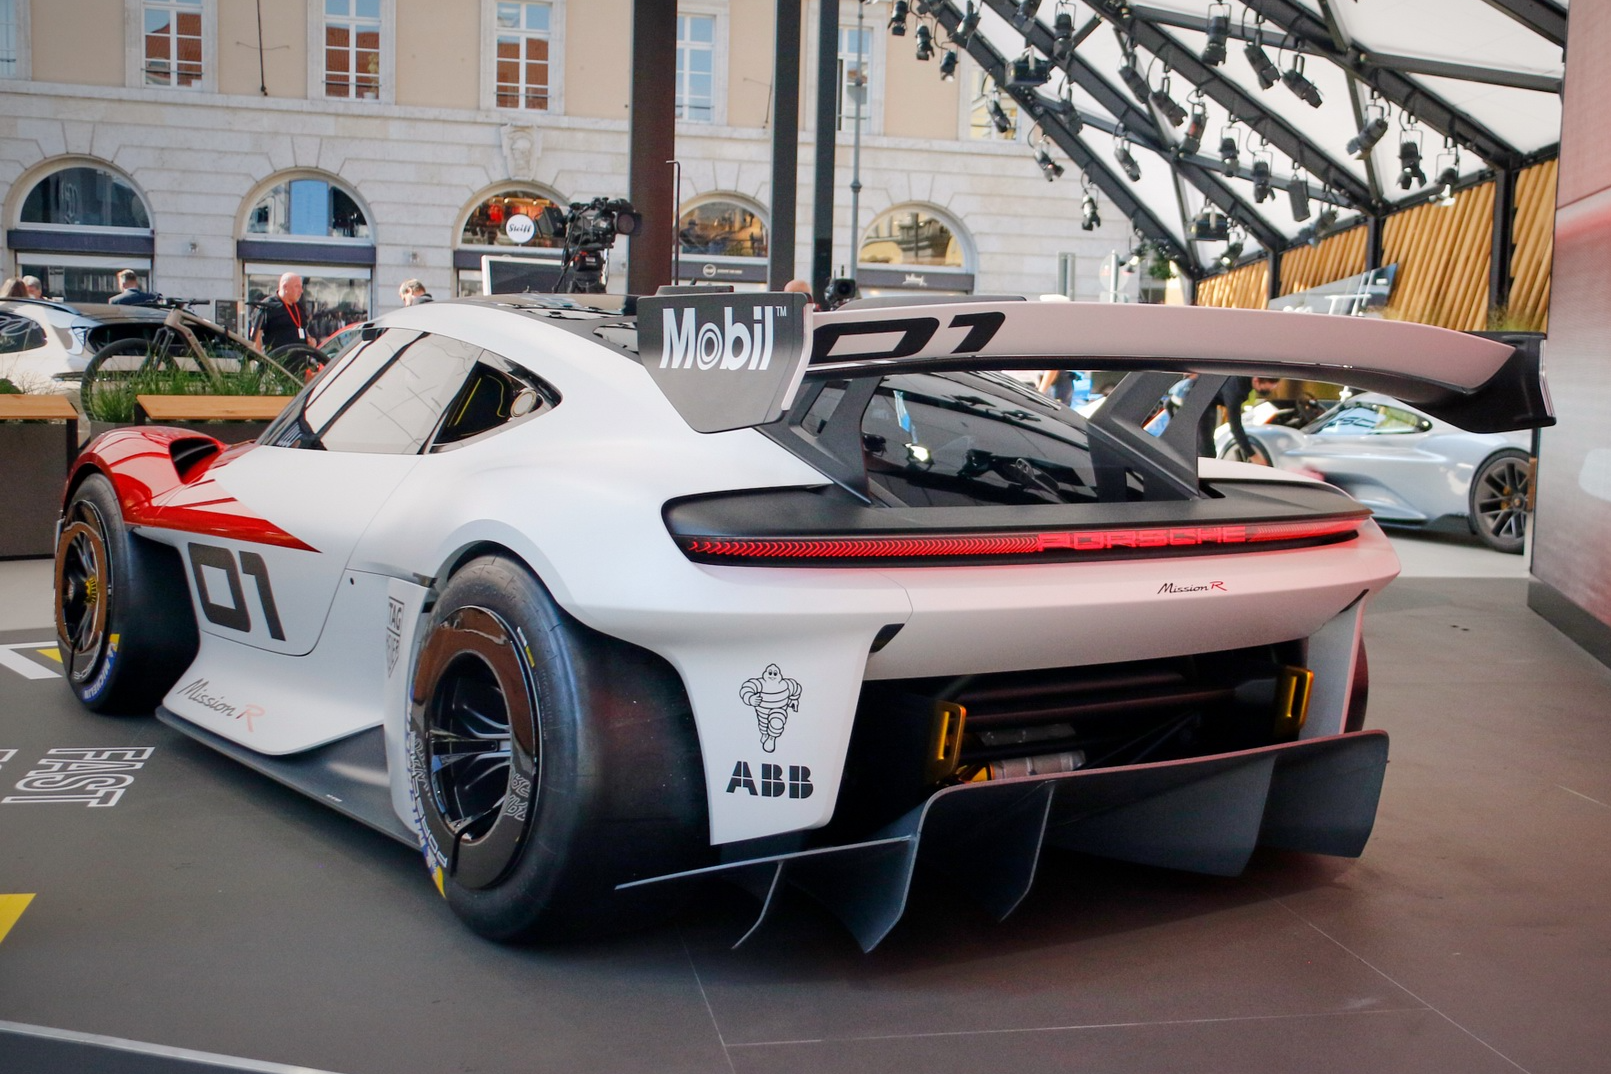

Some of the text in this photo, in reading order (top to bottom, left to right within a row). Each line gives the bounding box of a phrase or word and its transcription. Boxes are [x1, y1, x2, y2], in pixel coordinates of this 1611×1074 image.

[659, 306, 774, 371] Mobil
[812, 311, 1006, 364] 01
[1037, 526, 1246, 552] PORSCHE
[187, 541, 287, 642] 01
[1157, 580, 1228, 595] Mission R
[176, 678, 266, 733] Mission R
[2, 746, 156, 807] FAST
[726, 760, 814, 799] ABB
